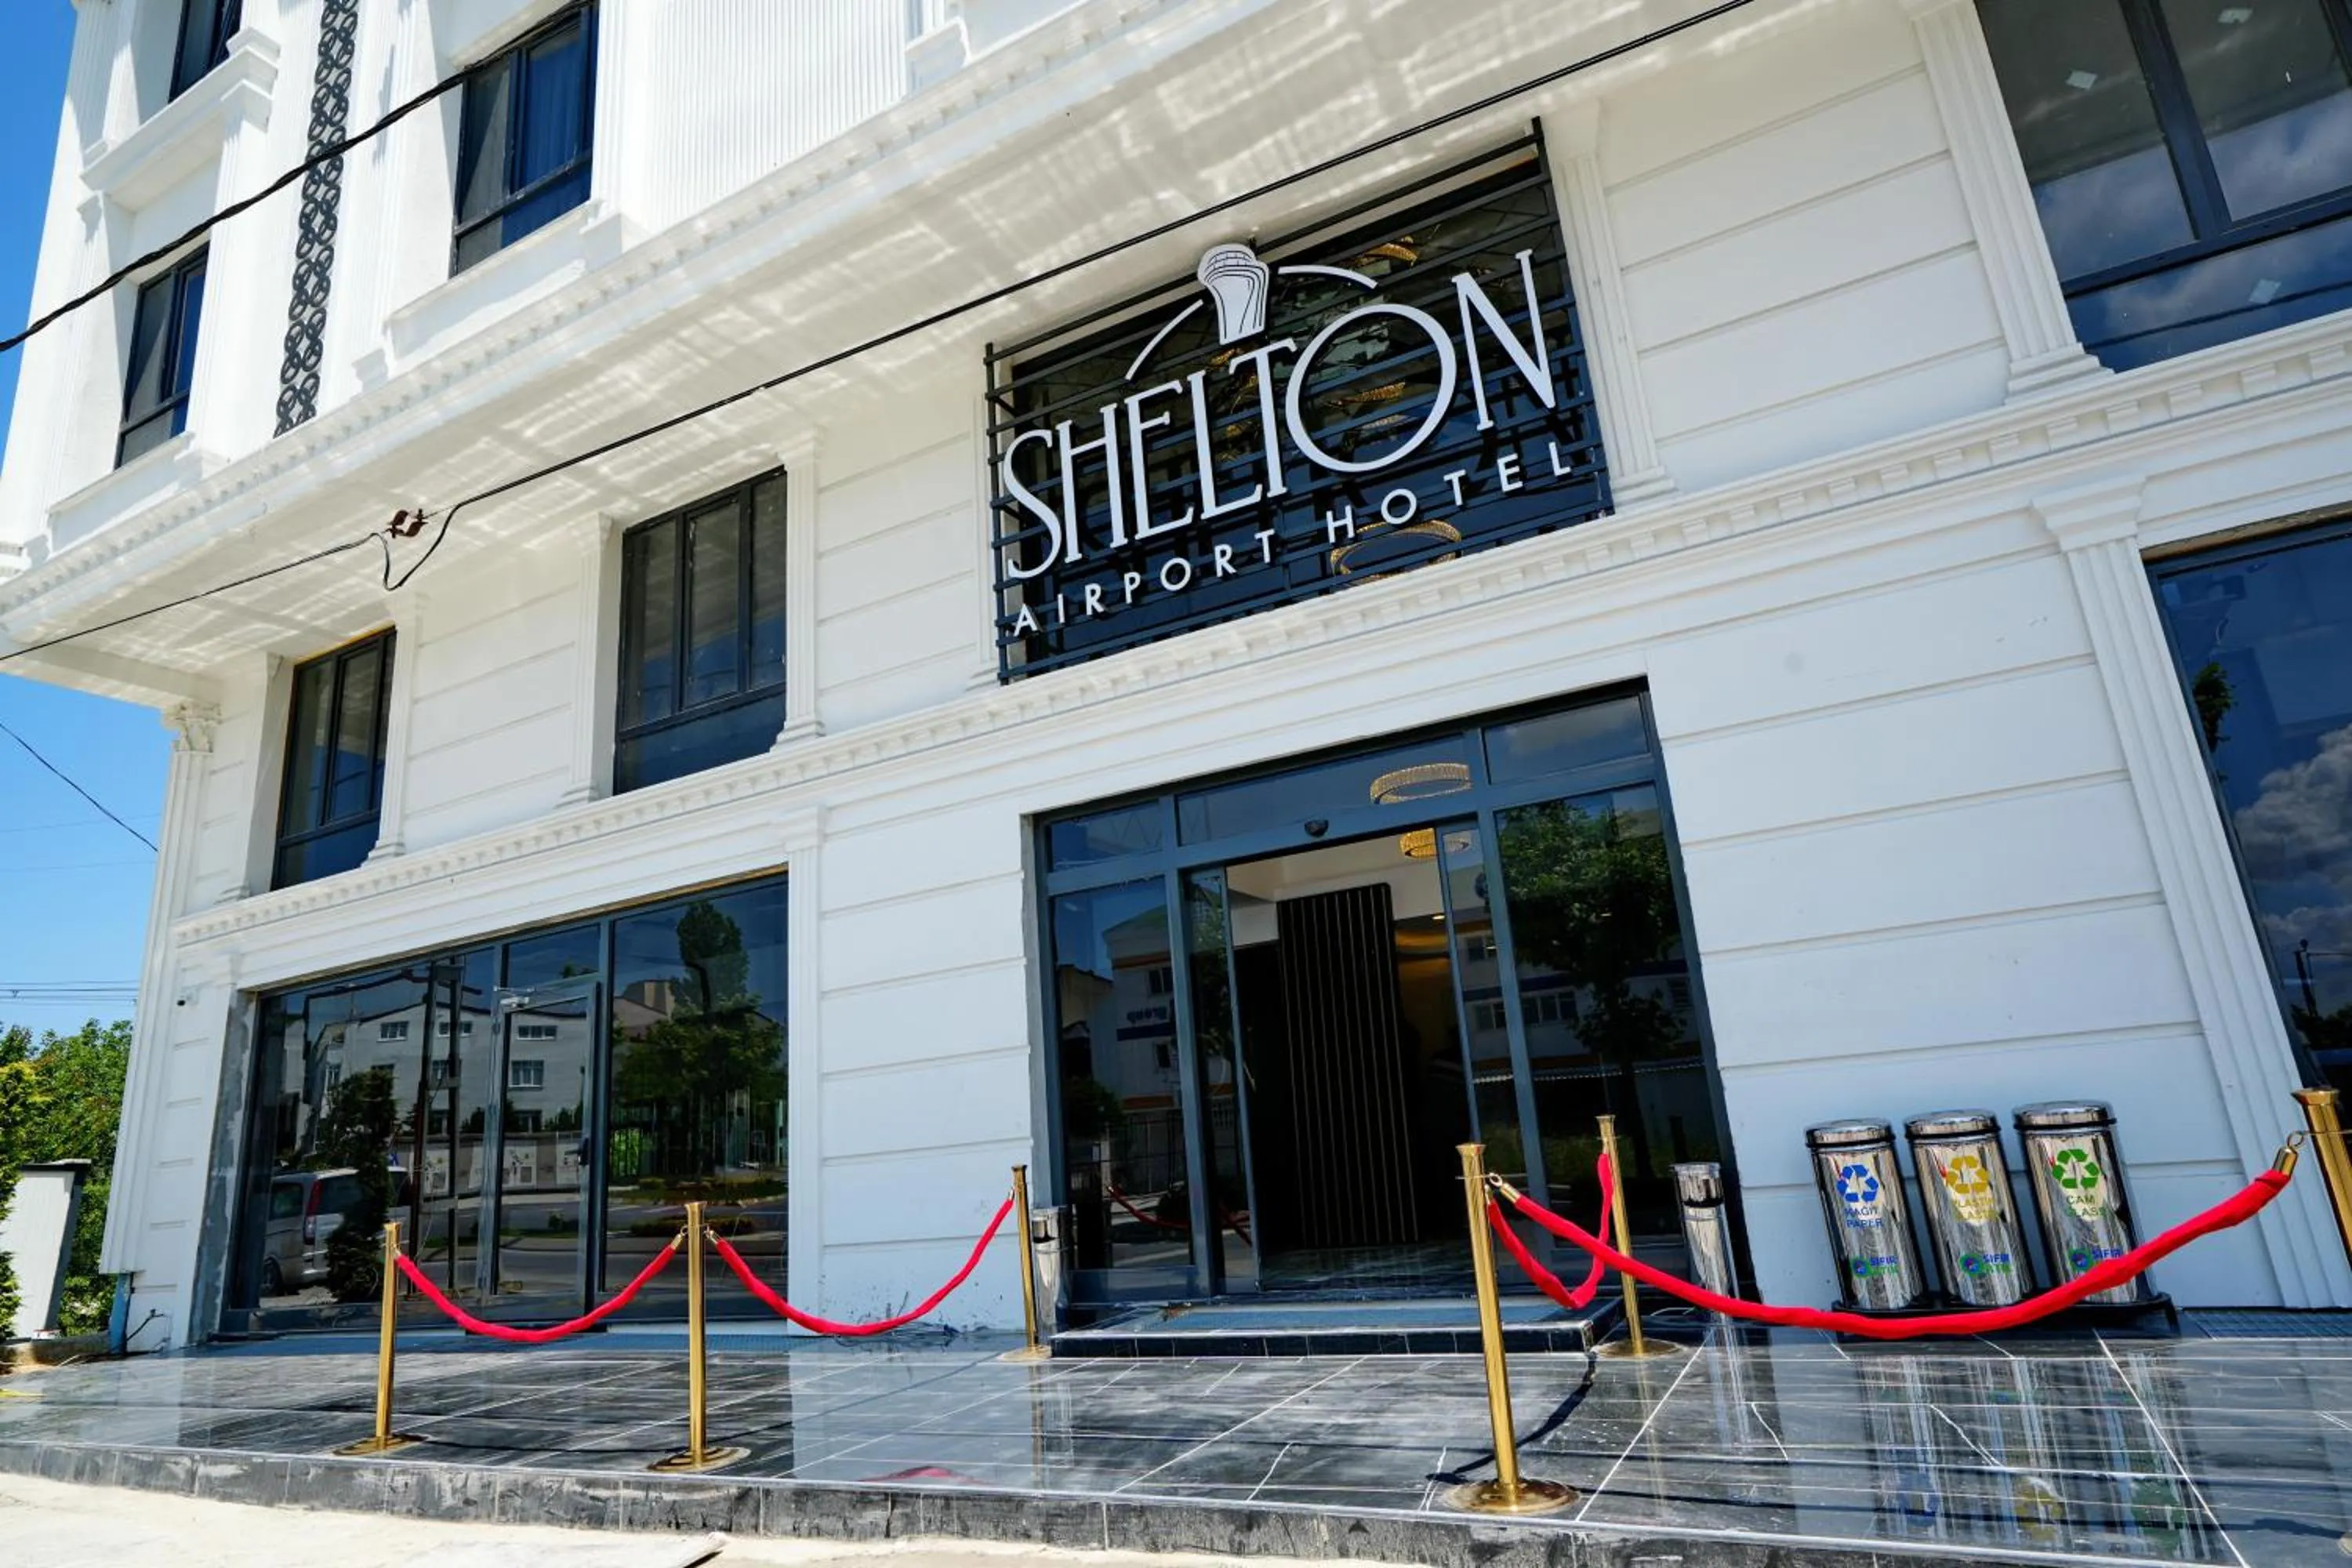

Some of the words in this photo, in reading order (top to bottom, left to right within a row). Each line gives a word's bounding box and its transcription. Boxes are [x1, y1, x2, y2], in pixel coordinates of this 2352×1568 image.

[1003, 249, 1556, 579] SHELTON
[1012, 529, 1276, 637] AIRPORT
[1326, 441, 1571, 543] HOTEL
